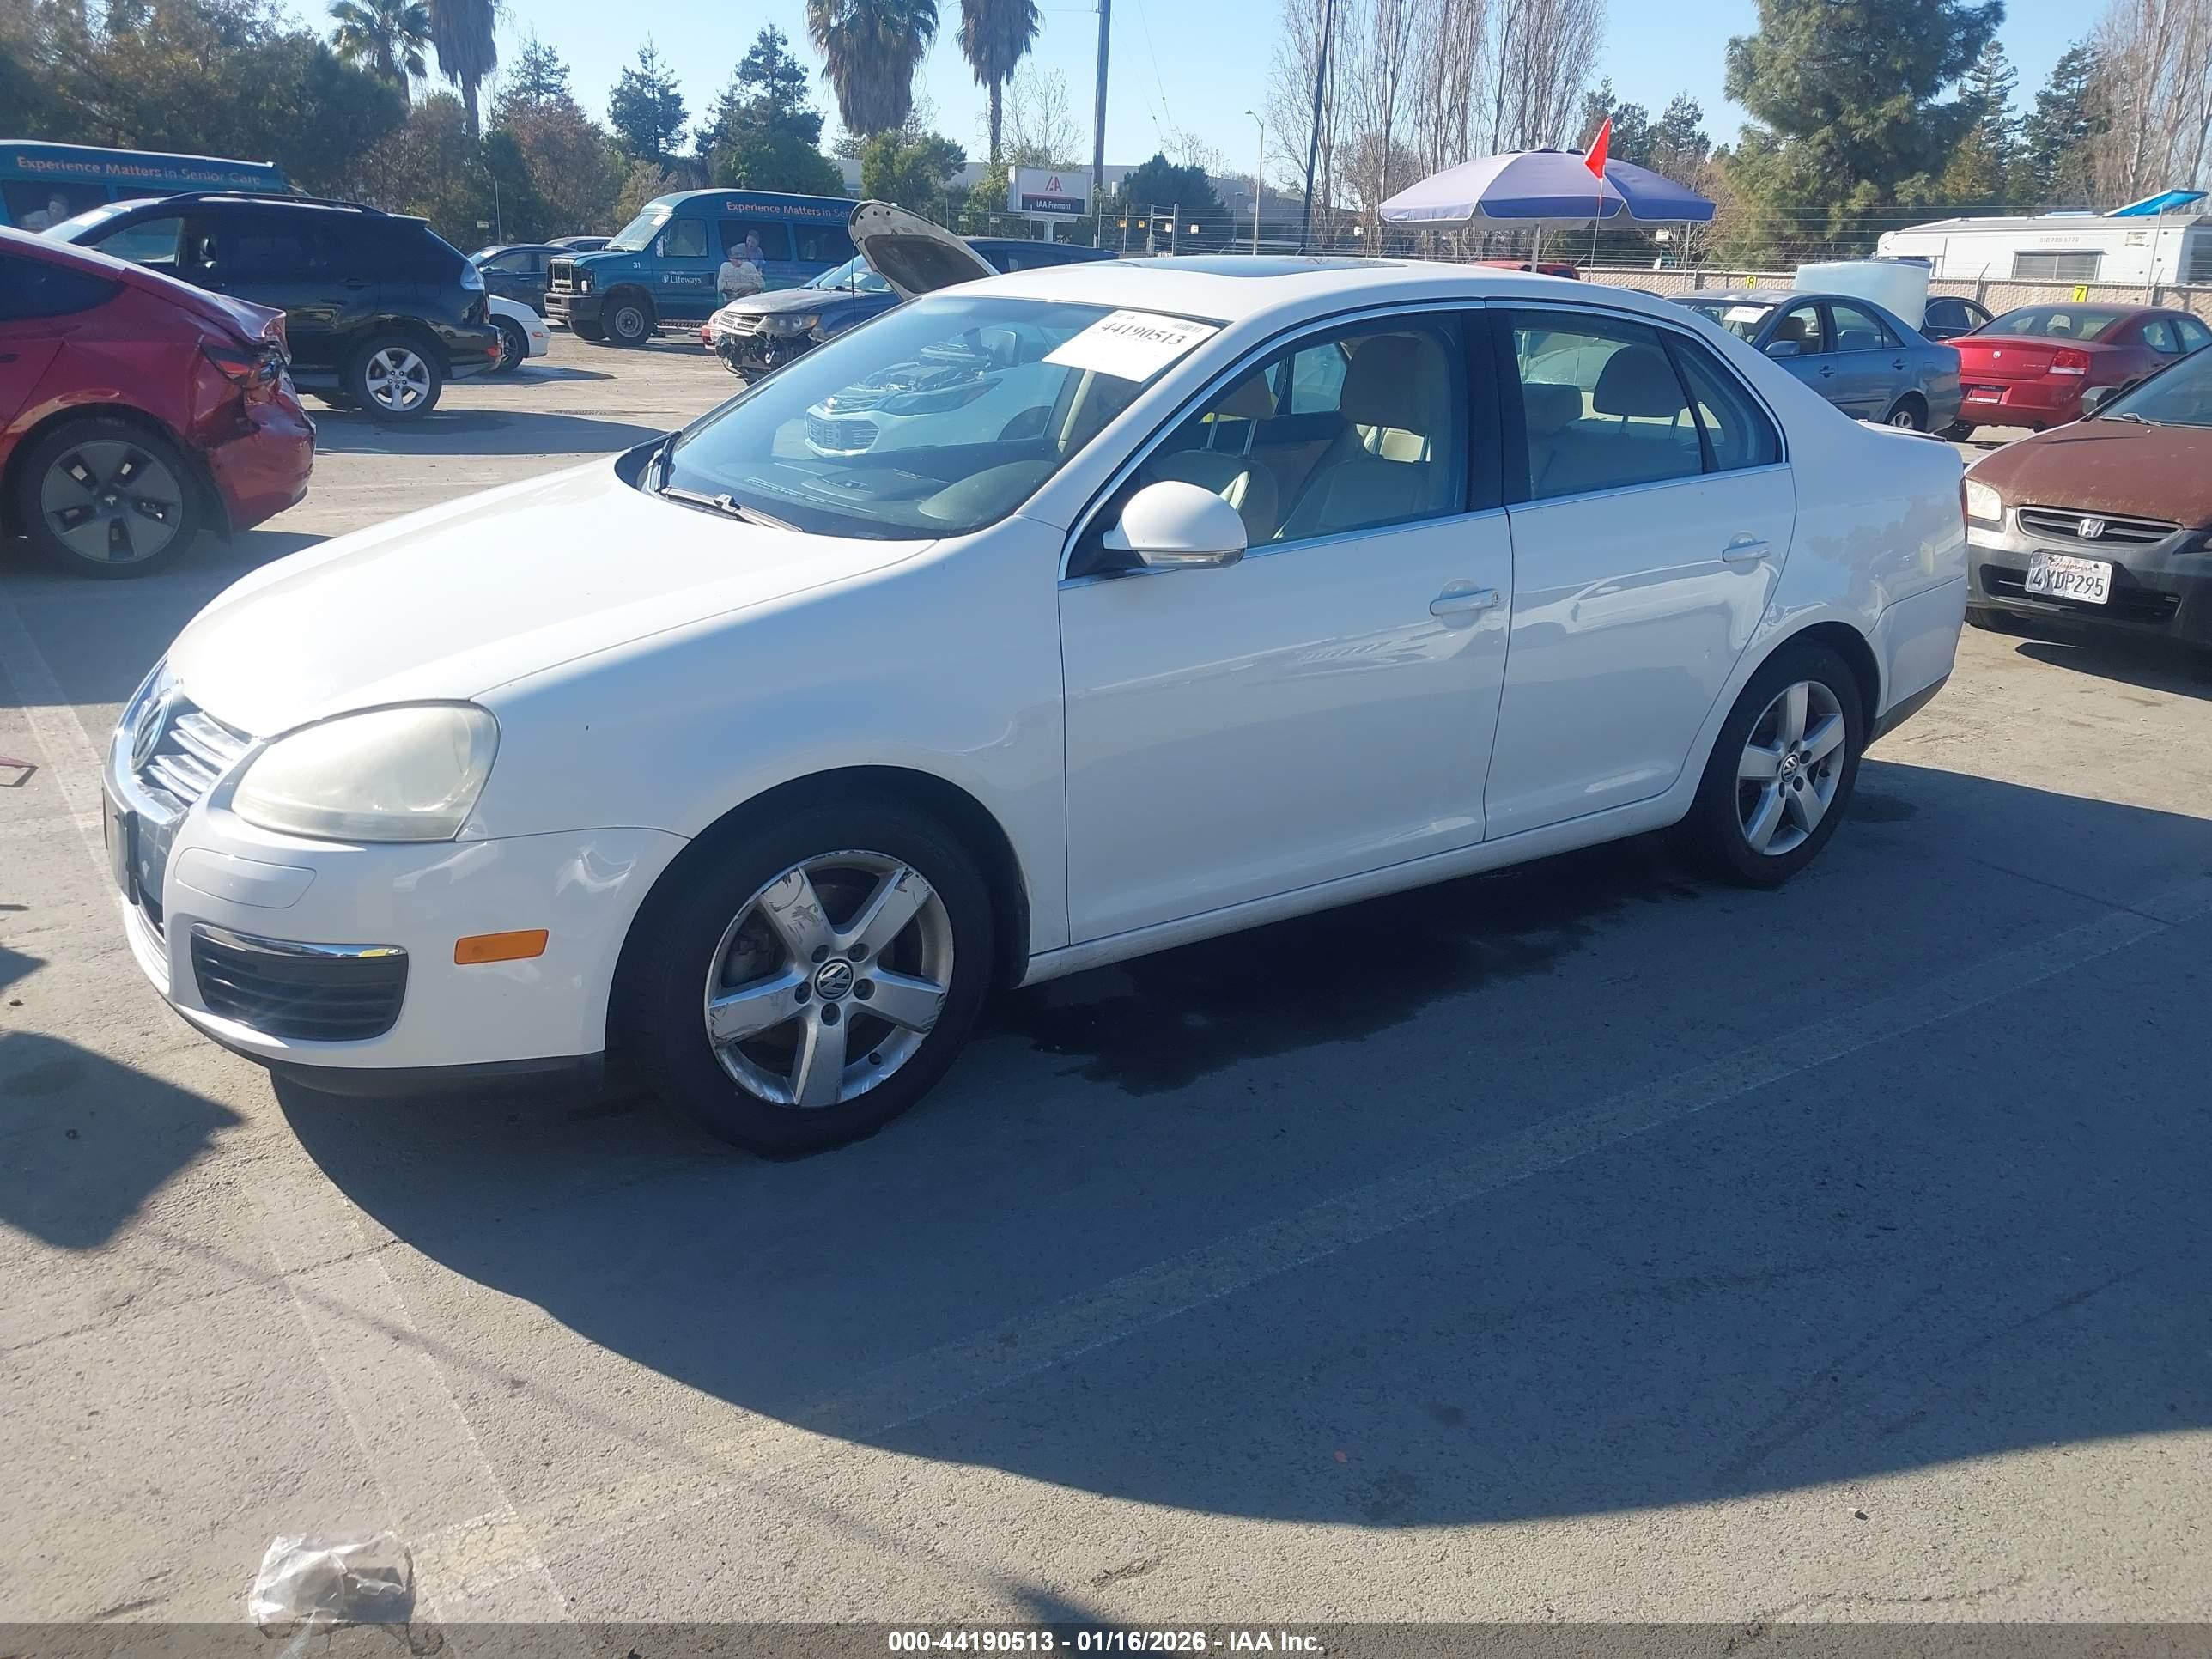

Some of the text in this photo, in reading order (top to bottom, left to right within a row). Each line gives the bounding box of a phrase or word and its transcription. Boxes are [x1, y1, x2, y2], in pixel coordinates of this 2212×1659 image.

[16, 156, 261, 185] Experience Matters in Senior Care
[726, 201, 780, 214] Experience
[783, 205, 821, 216] Matters
[823, 208, 831, 217] in
[1036, 198, 1071, 210] IAA Fremont
[670, 275, 702, 285] Lifeways
[2075, 288, 2085, 301] 7
[1101, 323, 1187, 345] 44190513
